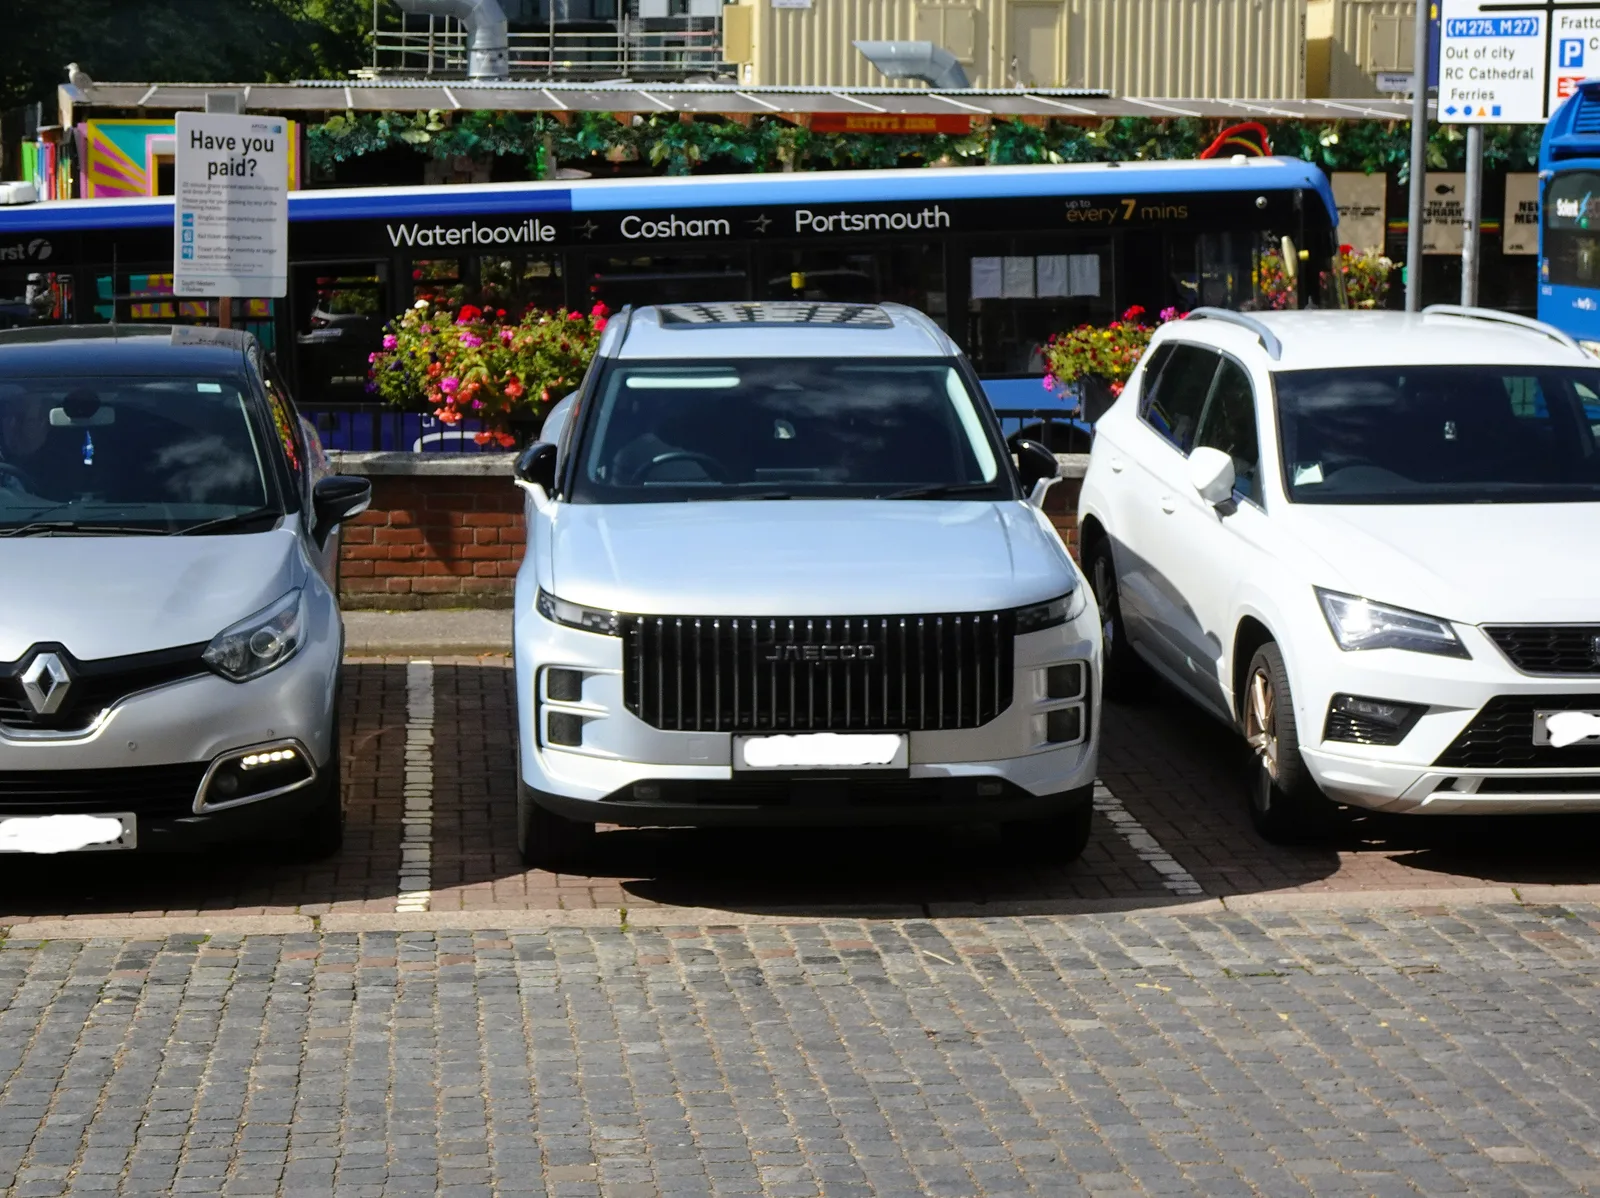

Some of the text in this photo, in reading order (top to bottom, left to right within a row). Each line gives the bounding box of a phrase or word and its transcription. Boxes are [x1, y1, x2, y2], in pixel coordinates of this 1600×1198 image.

[1500, 18, 1538, 35] M27)
[1446, 46, 1515, 61] Out of city
[1563, 40, 1582, 66] P
[1445, 67, 1534, 80] RC Cathedral
[1451, 88, 1495, 100] Ferries
[190, 129, 274, 156] Have you
[207, 157, 257, 181] paid?
[1065, 199, 1091, 209] up to
[1066, 199, 1188, 224] every 7 mins
[386, 205, 950, 247] Waterlooville Cosham Portsmouth
[765, 645, 875, 660] JAECOO
